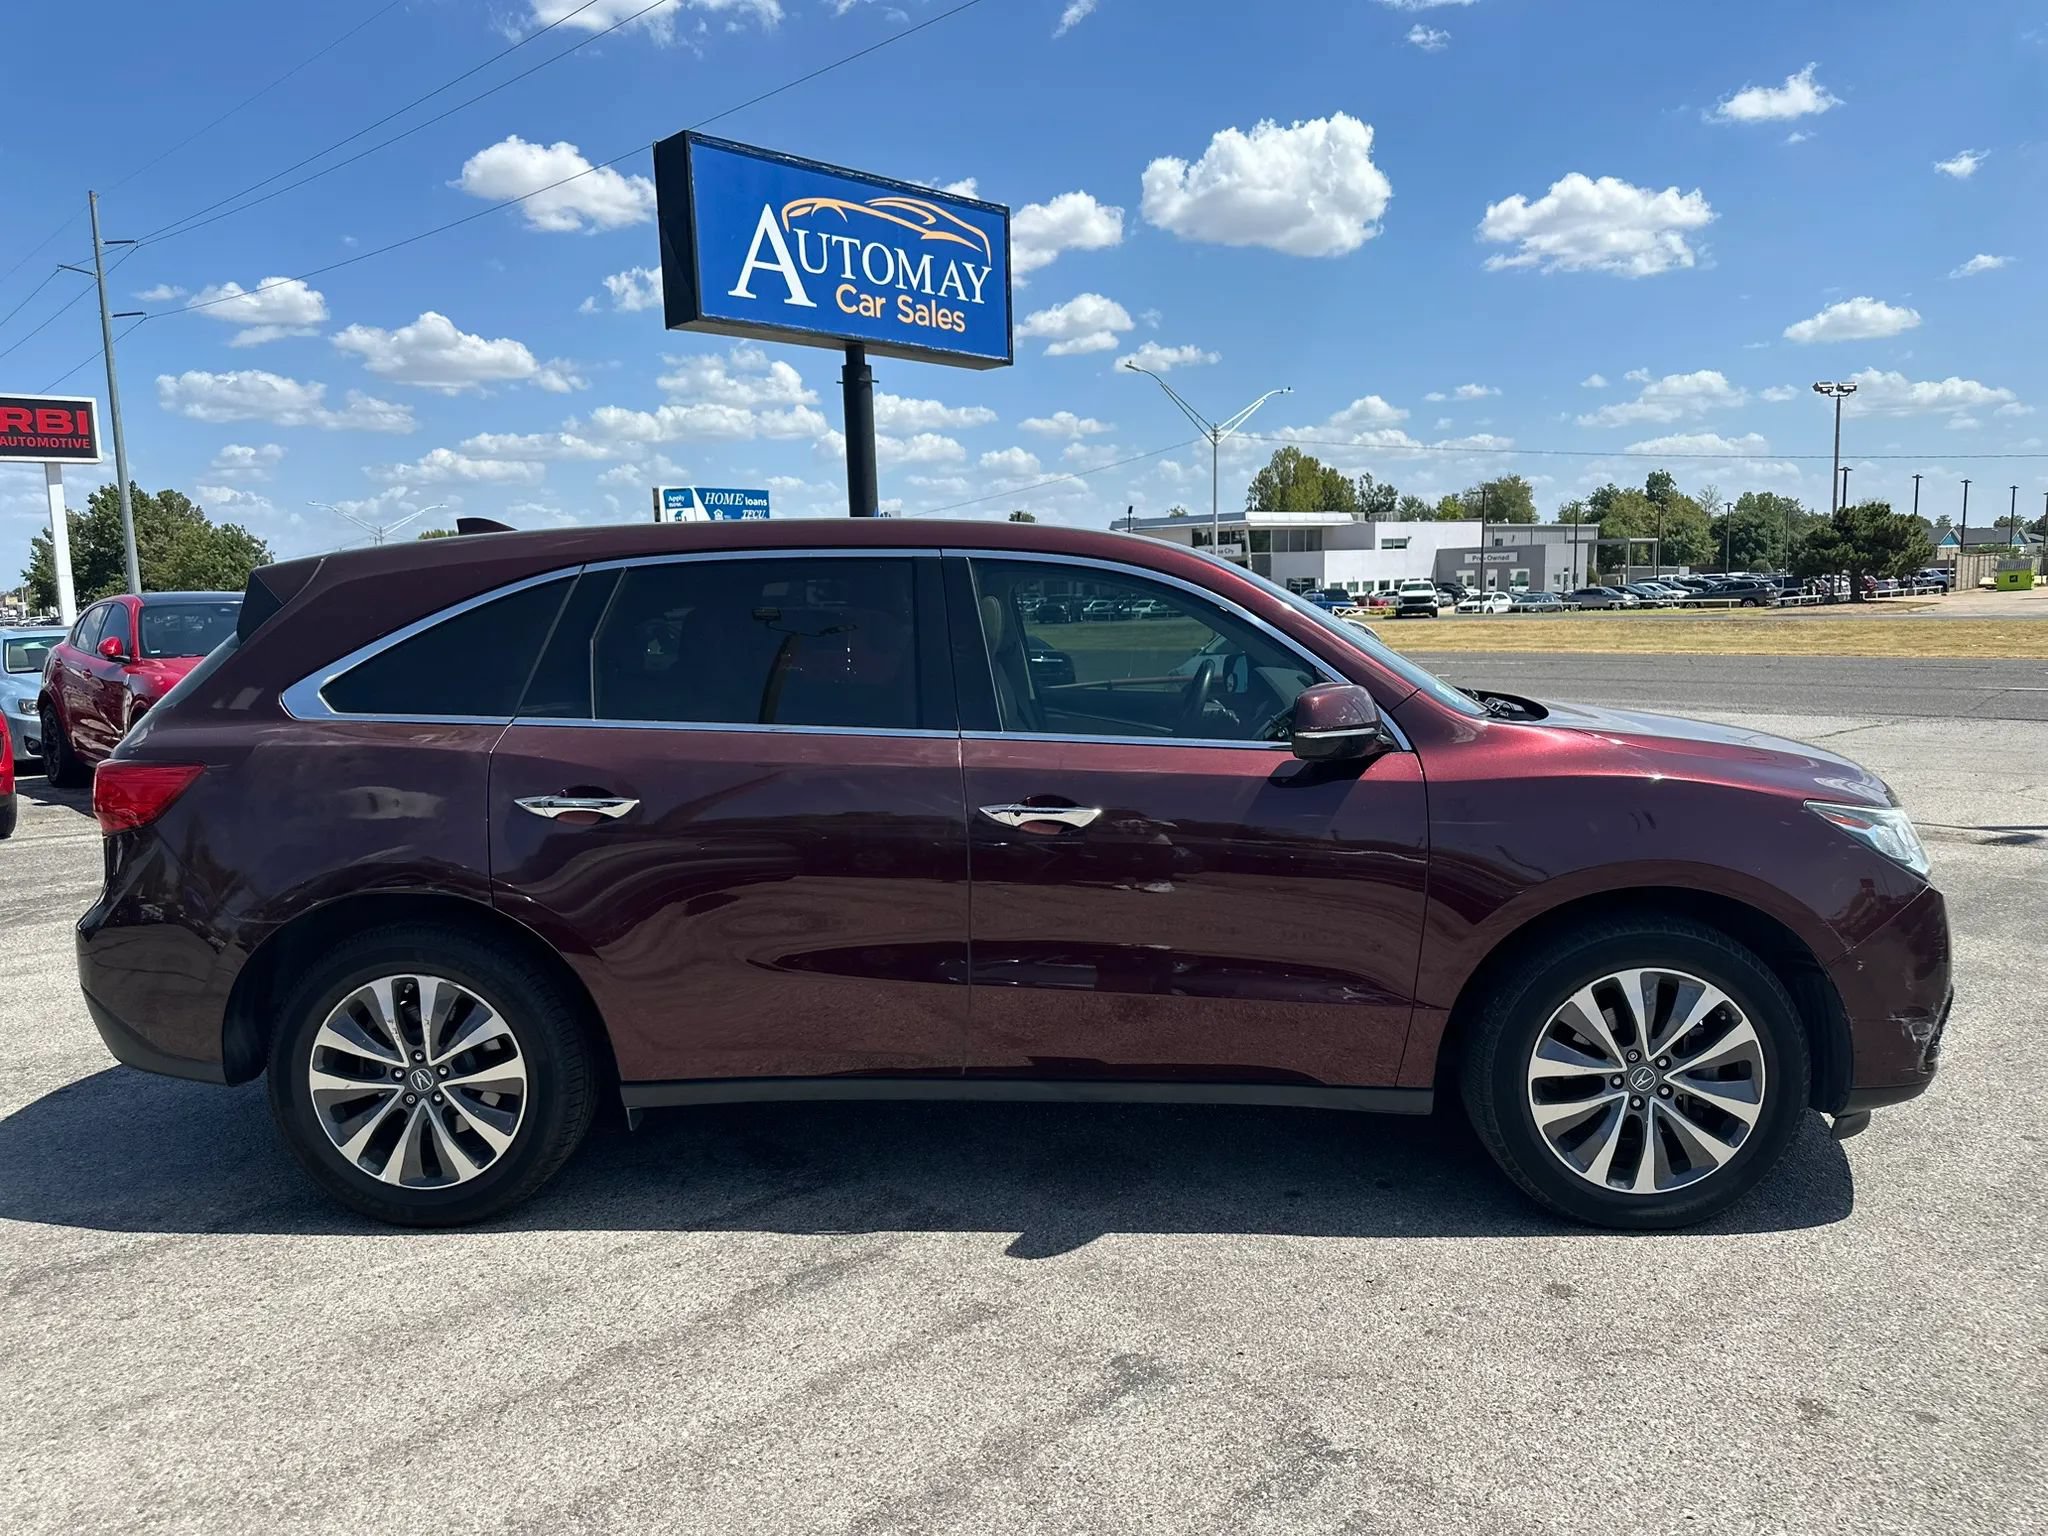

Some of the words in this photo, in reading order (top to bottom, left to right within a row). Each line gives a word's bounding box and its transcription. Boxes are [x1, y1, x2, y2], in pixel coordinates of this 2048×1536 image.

[836, 283, 886, 318] Car
[897, 294, 966, 333] Sales
[0, 406, 89, 435] RBI
[0, 436, 91, 449] AUTOMOTIVE
[704, 492, 744, 506] HOME
[745, 497, 767, 506] loans
